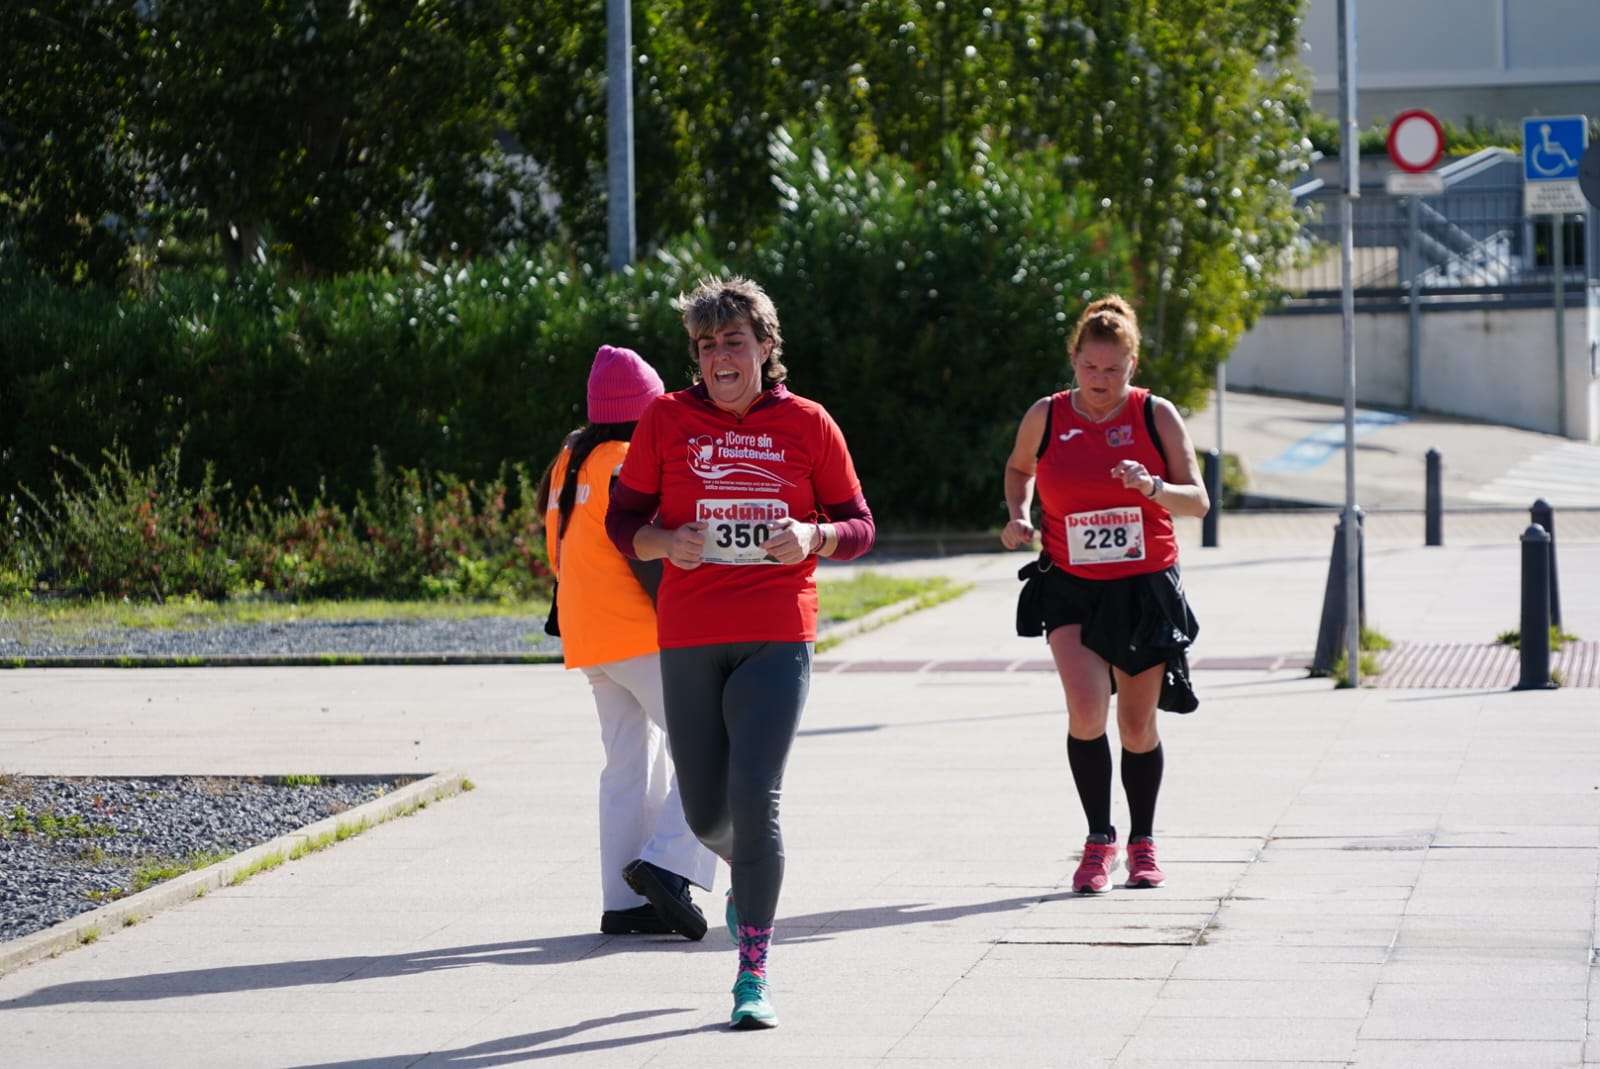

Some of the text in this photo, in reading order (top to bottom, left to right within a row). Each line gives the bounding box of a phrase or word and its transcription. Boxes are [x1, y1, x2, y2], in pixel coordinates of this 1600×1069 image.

[725, 431, 773, 448] ¡Corre sin
[718, 446, 786, 463] resistencias!
[699, 503, 787, 520] bedunia
[1068, 512, 1140, 527] bedunia
[716, 523, 770, 548] 350
[1083, 527, 1127, 550] 228
